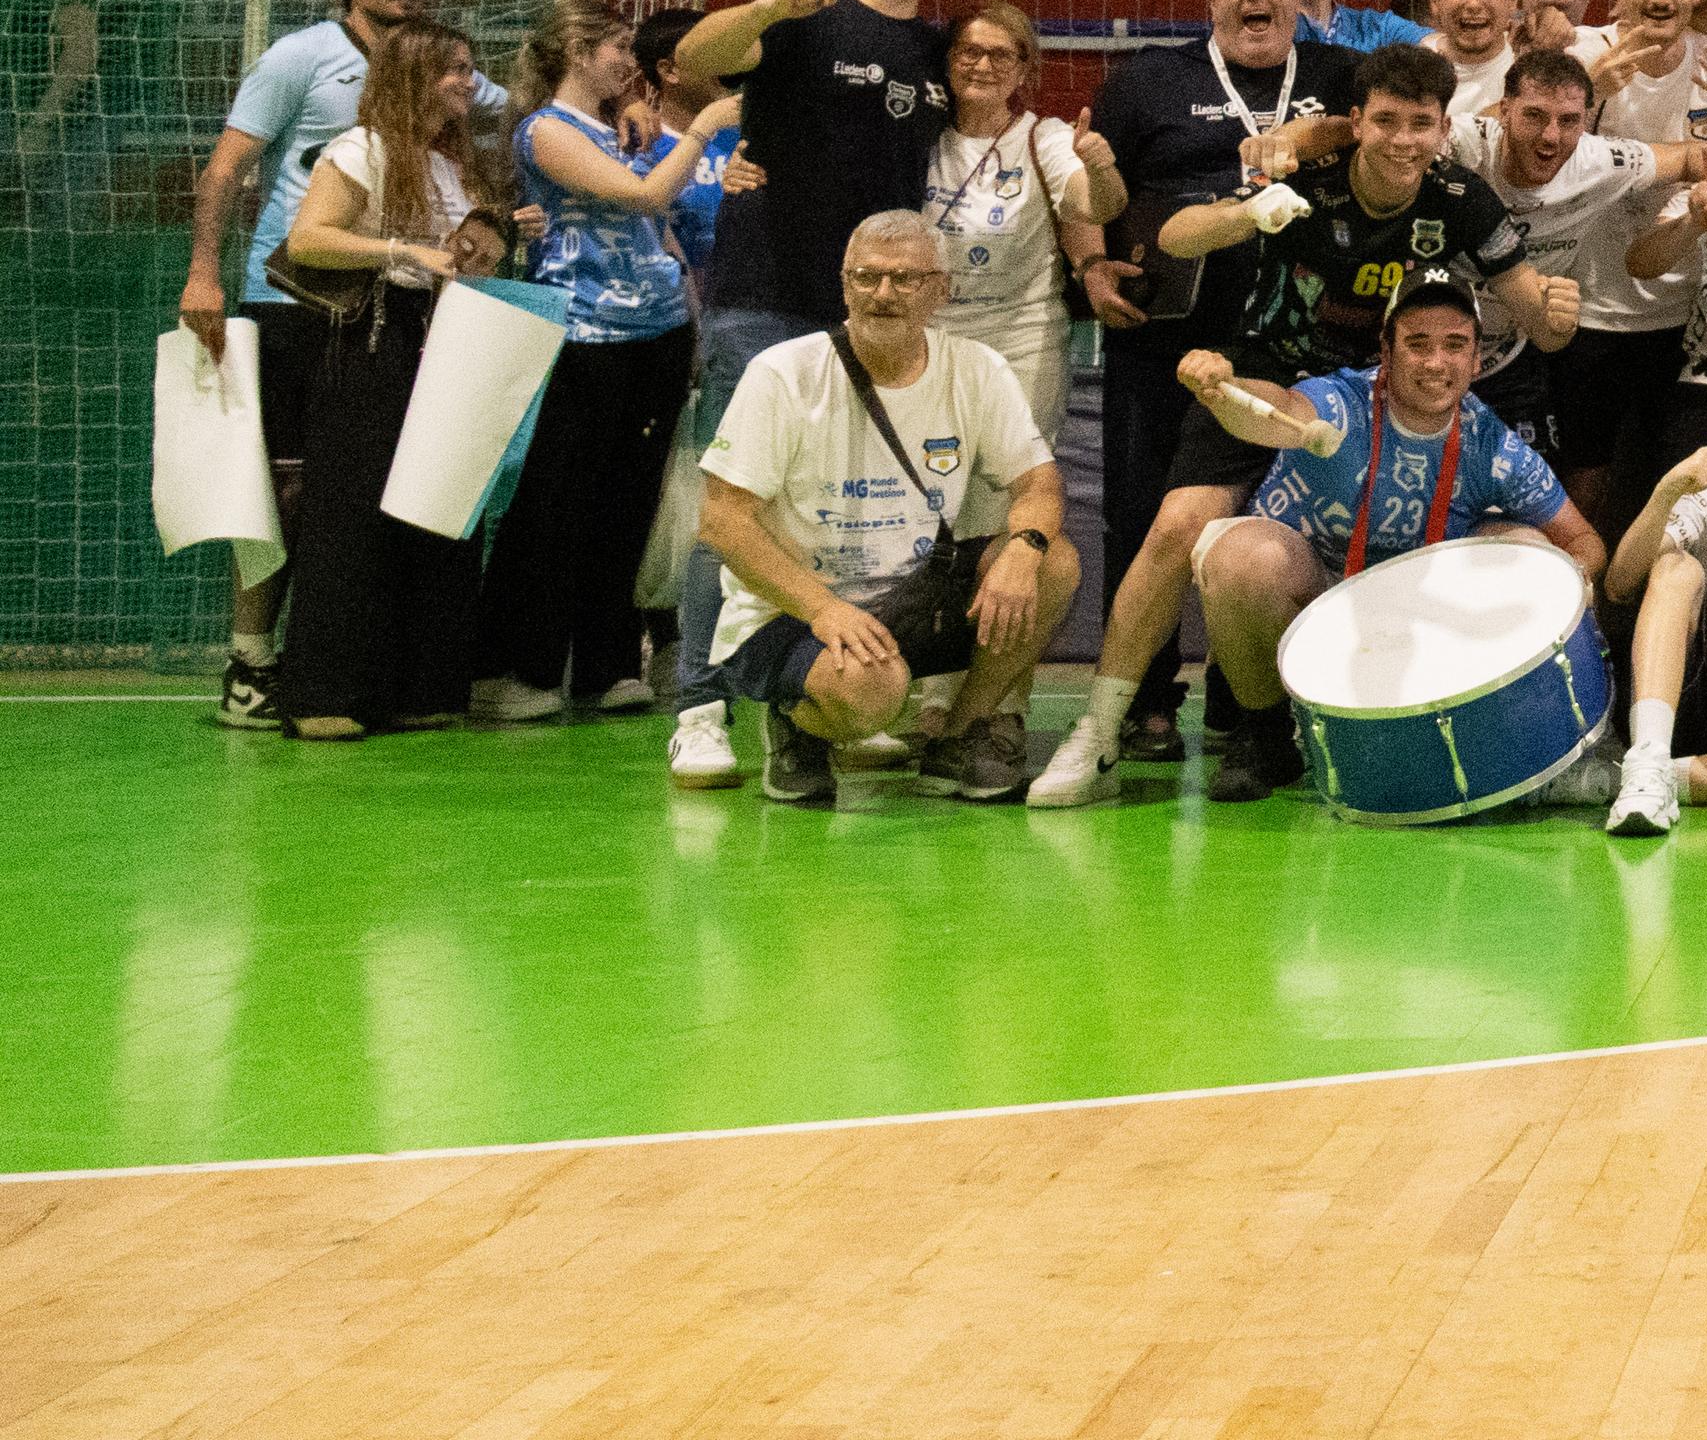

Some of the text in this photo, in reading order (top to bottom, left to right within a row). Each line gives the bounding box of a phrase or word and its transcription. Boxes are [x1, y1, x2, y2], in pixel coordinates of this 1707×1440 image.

[1353, 261, 1404, 297] 69
[842, 479, 869, 499] MG
[1378, 496, 1425, 536] 23
